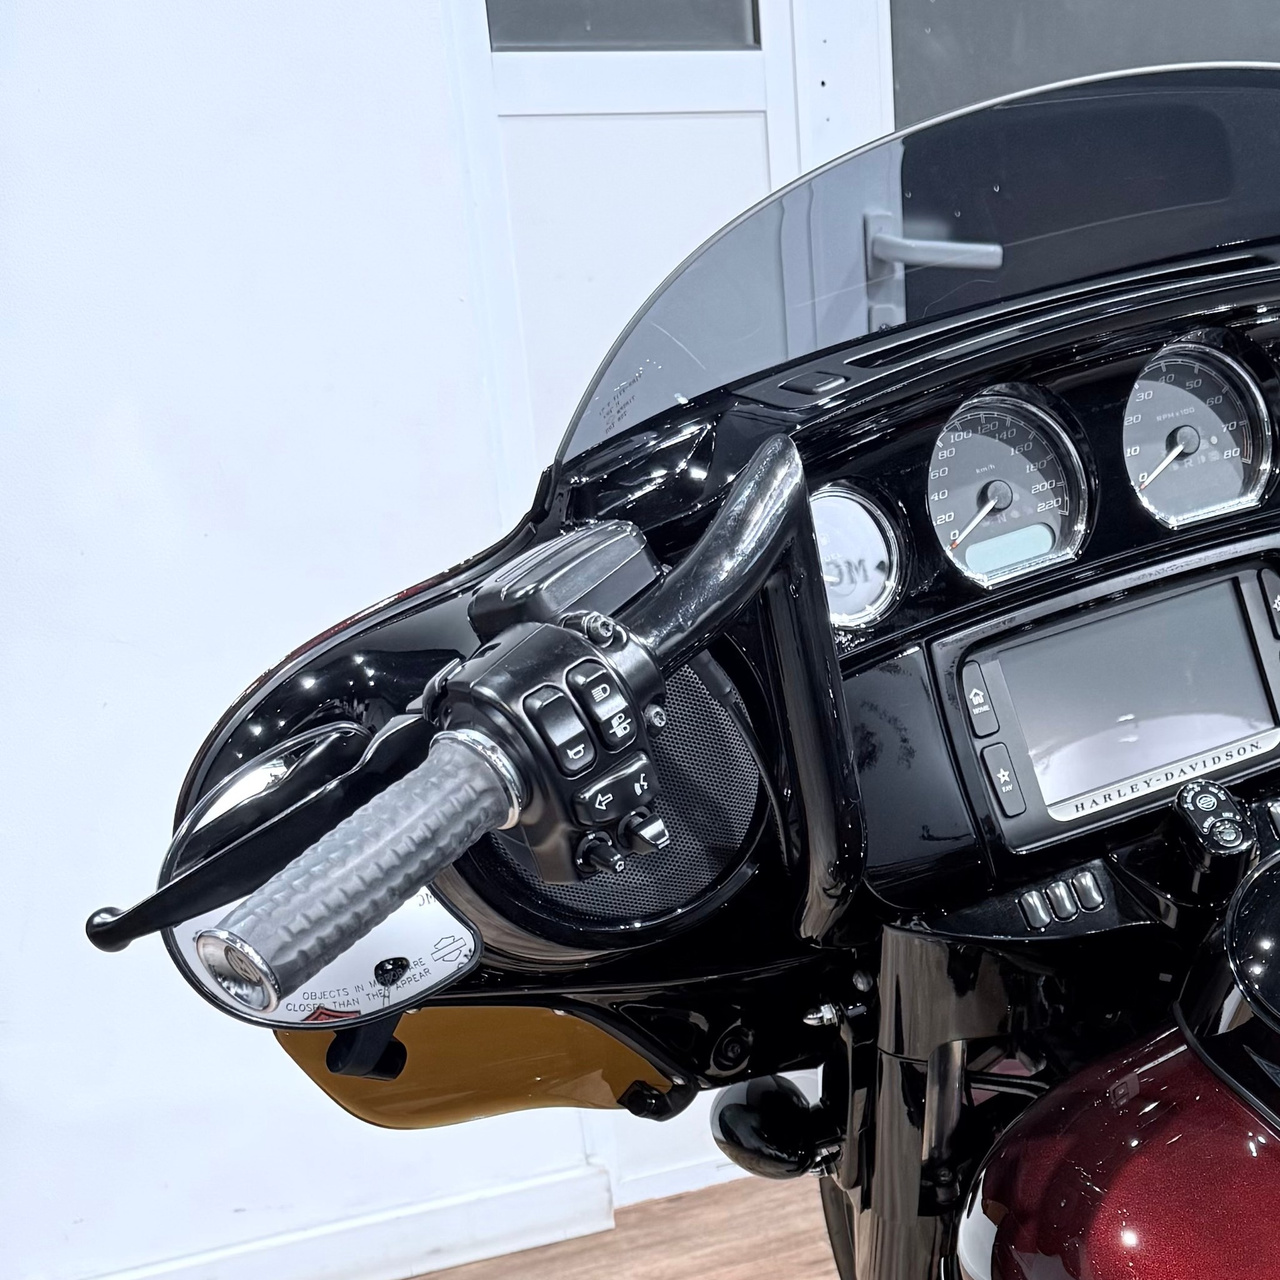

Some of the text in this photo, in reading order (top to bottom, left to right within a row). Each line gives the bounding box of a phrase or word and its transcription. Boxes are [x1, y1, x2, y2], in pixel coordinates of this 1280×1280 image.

[1185, 378, 1202, 390] 50
[1135, 390, 1153, 402] 30
[1206, 395, 1223, 407] 60
[1124, 414, 1141, 426] 20
[978, 421, 999, 435] 120
[1221, 421, 1237, 433] 70
[950, 429, 972, 443] 100
[995, 428, 1017, 442] 140
[938, 447, 956, 460] 80
[1010, 441, 1033, 456] 160
[1126, 446, 1140, 457] 10
[1223, 447, 1240, 459] 80
[1026, 459, 1047, 473] 180
[930, 467, 949, 480] 60
[1138, 472, 1148, 482] 0
[1031, 479, 1056, 494] 200
[930, 489, 948, 501] 40
[1037, 497, 1062, 513] 220
[936, 511, 955, 525] 20
[950, 529, 960, 540] 0
[1074, 741, 1261, 814] HARLEY-DAVIDSON
[302, 989, 350, 1001] OBJECTS
[354, 984, 365, 994] IN
[408, 957, 426, 972] ARE
[332, 998, 360, 1010] THAN
[395, 967, 432, 991] APPEAR
